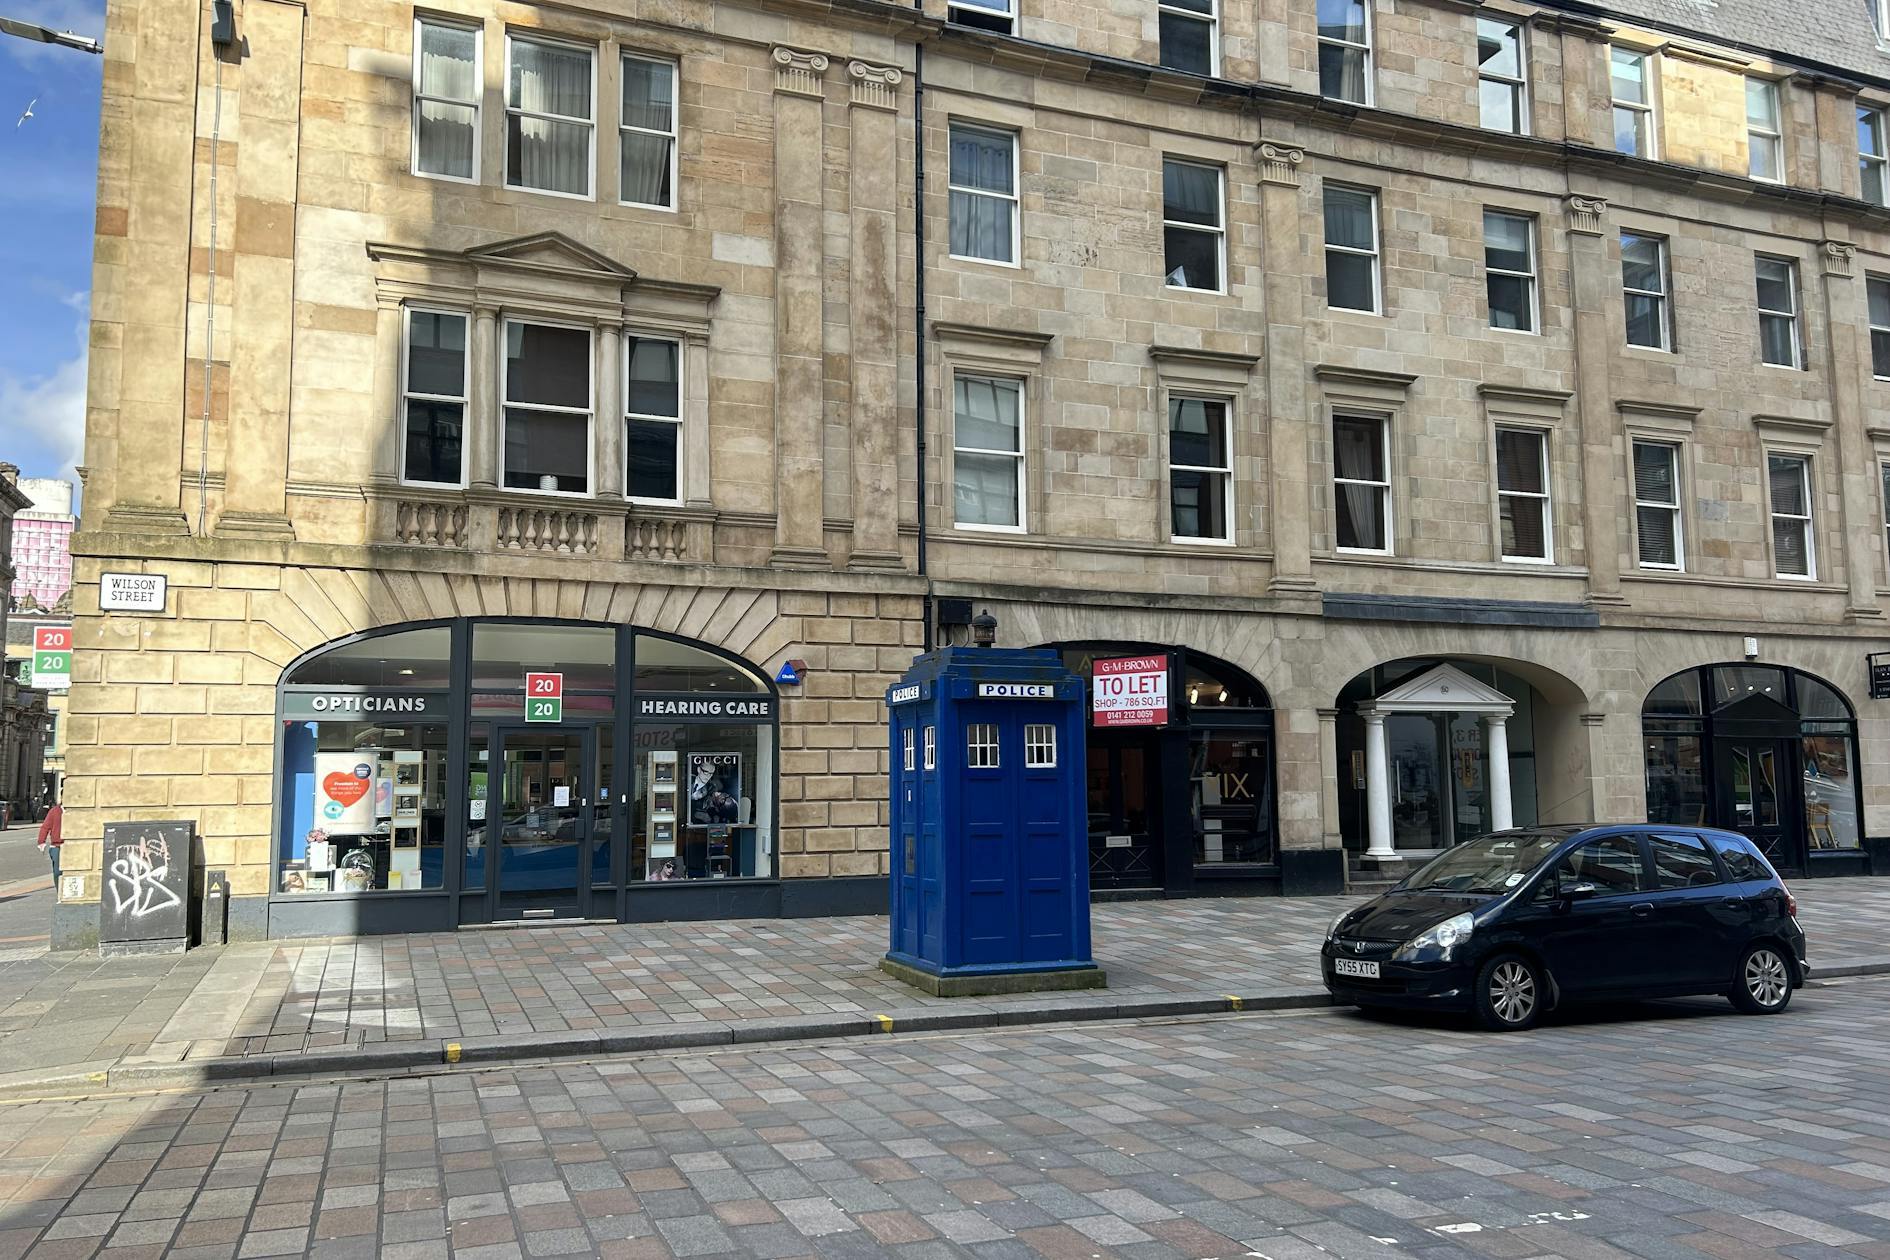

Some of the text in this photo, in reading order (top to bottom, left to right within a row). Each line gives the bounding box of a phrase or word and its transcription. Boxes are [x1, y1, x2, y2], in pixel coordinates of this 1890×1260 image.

[111, 578, 156, 590] WILSON
[111, 590, 155, 602] STREET
[43, 633, 65, 646] 20
[42, 656, 63, 670] 20
[534, 679, 554, 693] 20
[986, 685, 1046, 696] POLICE
[1099, 674, 1161, 696] TO LET
[894, 686, 917, 699] POLICE
[312, 695, 426, 712] OPTICIANS
[641, 700, 769, 715] HEARING CARE
[1094, 698, 1118, 708] SHOP
[1124, 697, 1140, 707] 786
[534, 703, 553, 716] 20
[1107, 710, 1154, 720] 0141 212 0059
[693, 756, 737, 765] GUCCI
[1337, 960, 1377, 975] SY55 XTC
